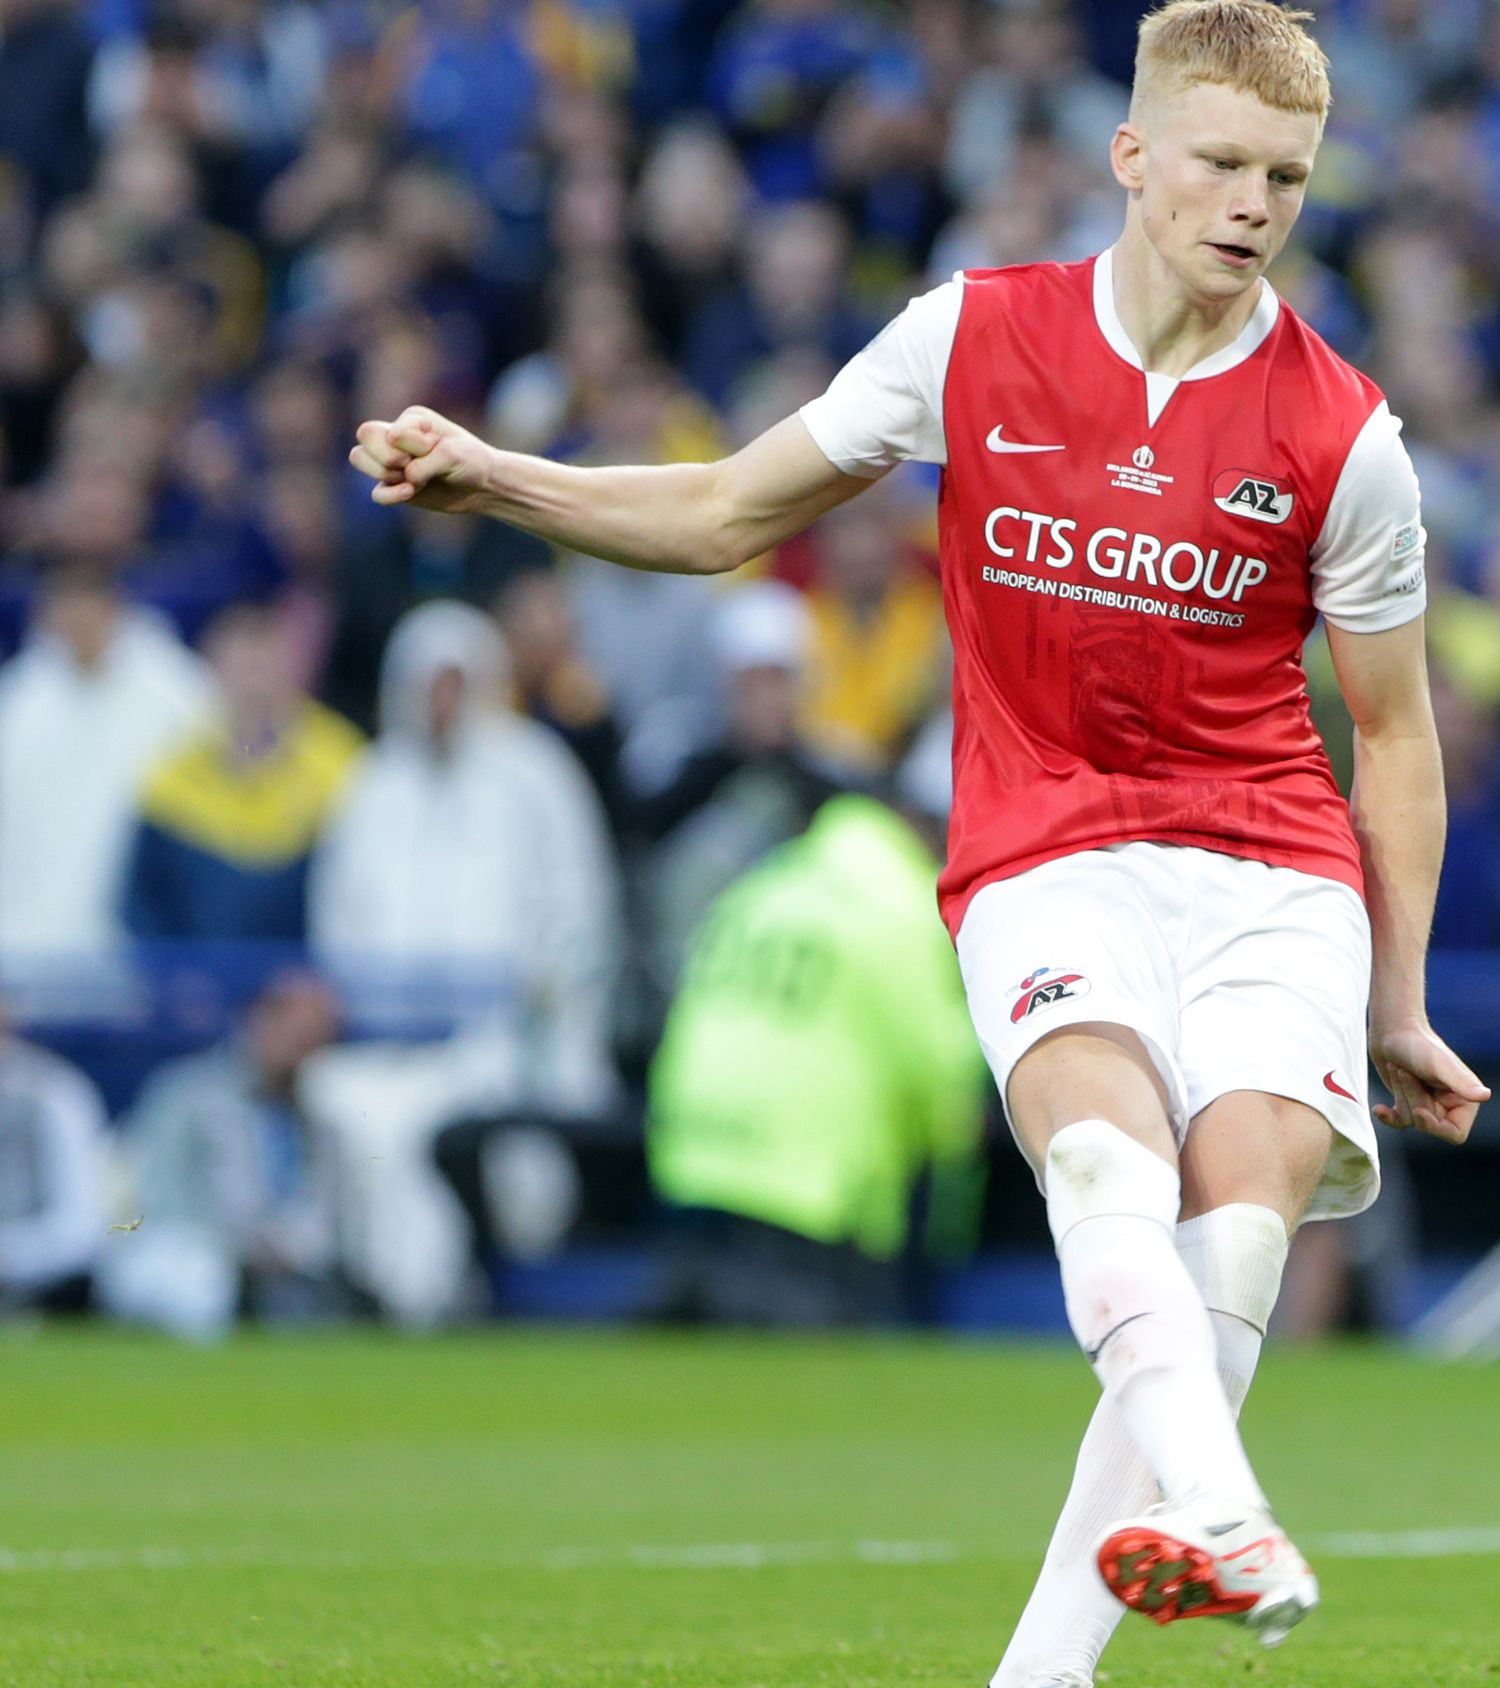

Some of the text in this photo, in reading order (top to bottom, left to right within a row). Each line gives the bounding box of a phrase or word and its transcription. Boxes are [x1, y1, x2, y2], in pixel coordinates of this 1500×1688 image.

[1227, 480, 1279, 515] AZ
[984, 506, 1267, 602] CTS GROUP
[982, 565, 1245, 627] EUROPEAN DISTRIBUTION & LOGISTICS
[1027, 983, 1076, 1015] AZ
